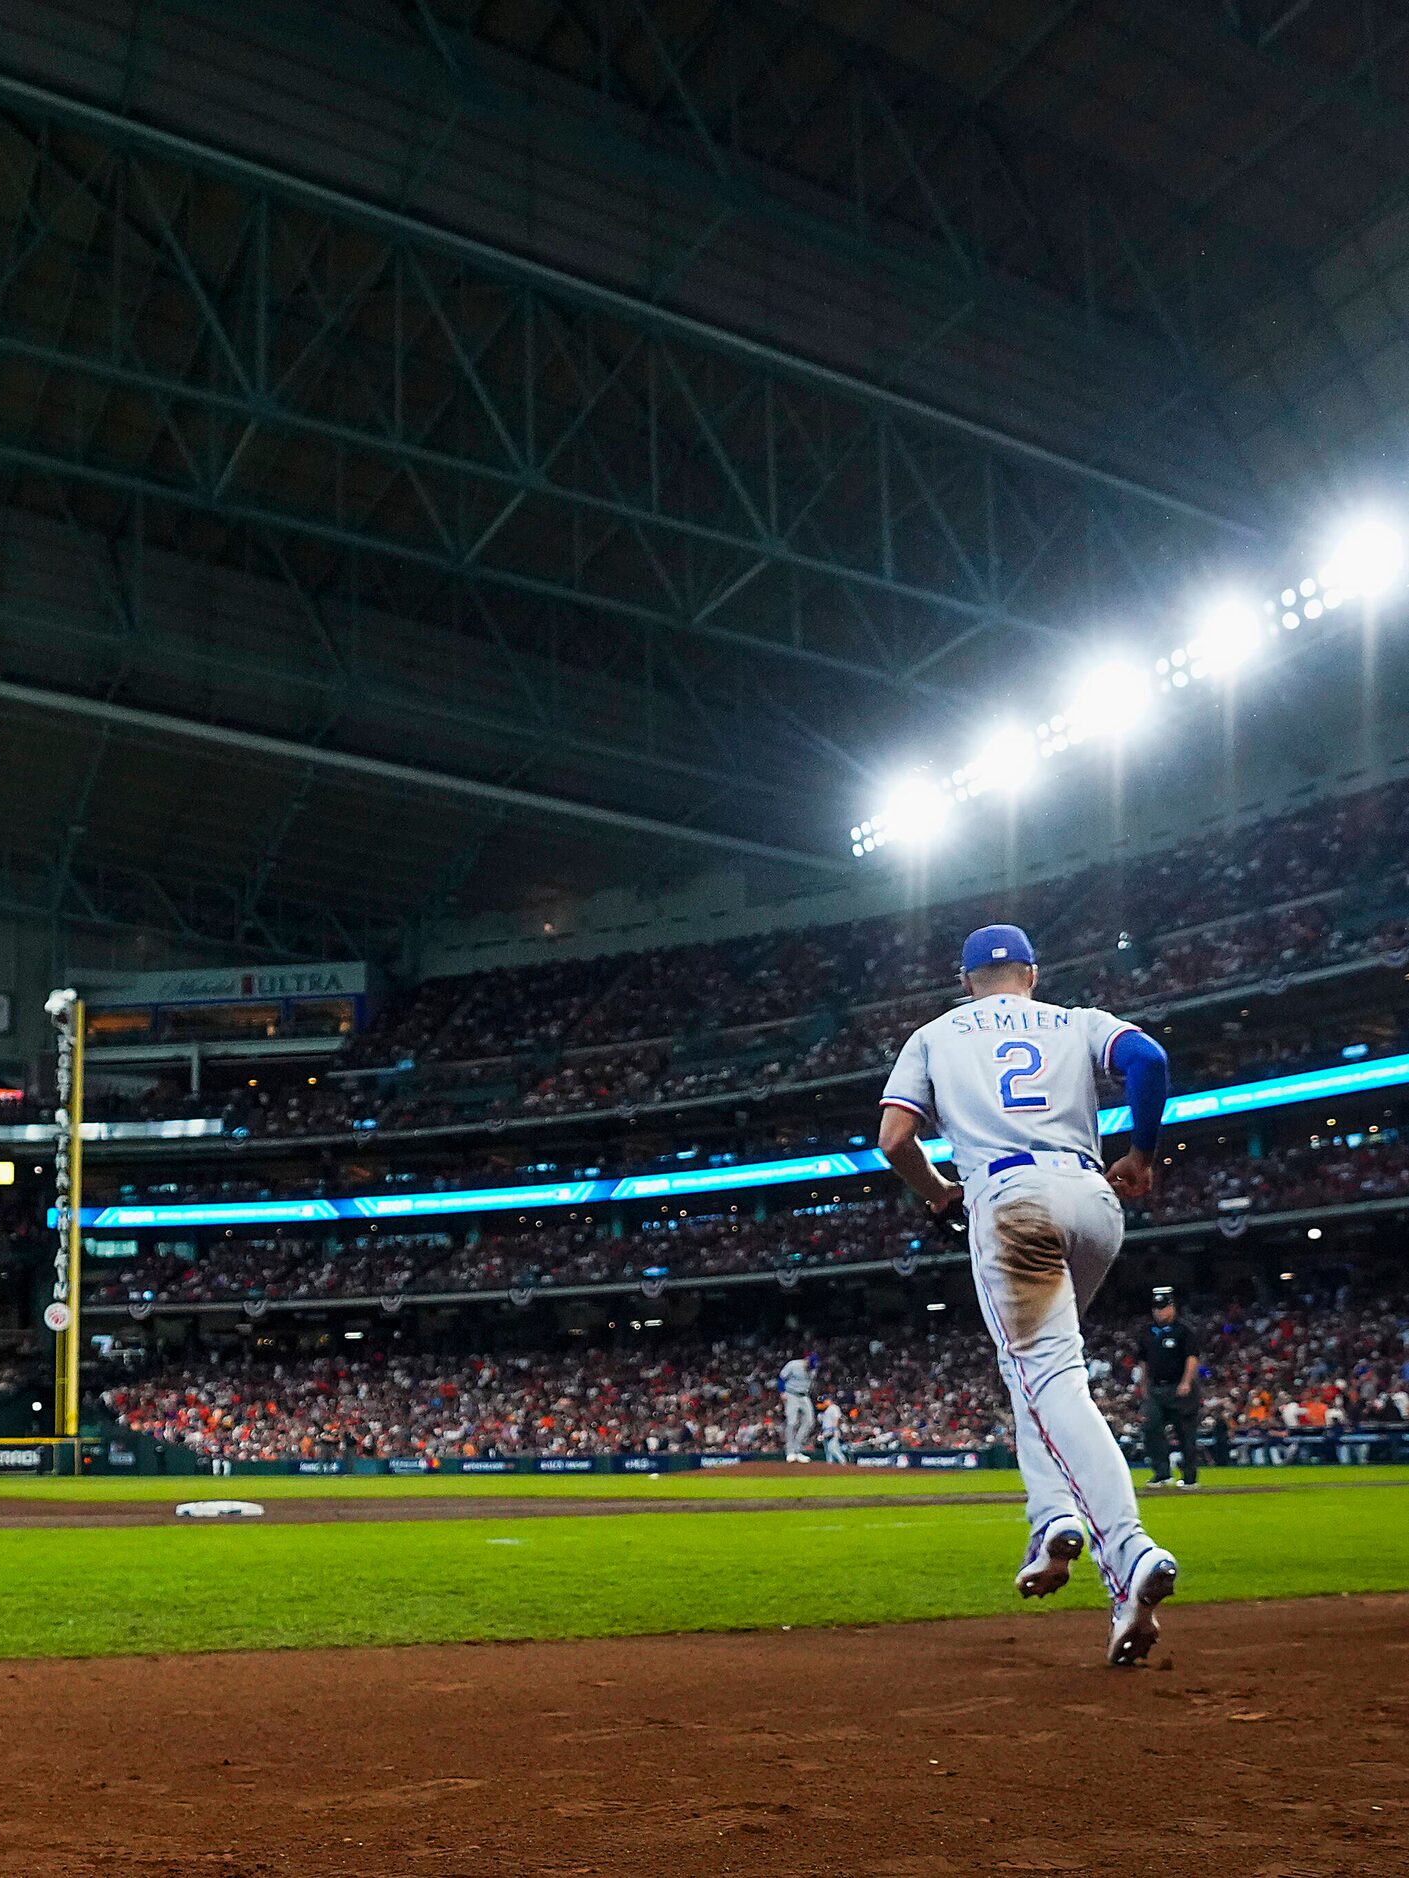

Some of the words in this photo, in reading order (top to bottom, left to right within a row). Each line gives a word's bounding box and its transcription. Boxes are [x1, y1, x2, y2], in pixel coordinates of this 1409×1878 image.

[258, 972, 343, 993] ULTRA
[952, 1009, 1071, 1034] SEMIEN
[993, 1037, 1052, 1113] 2
